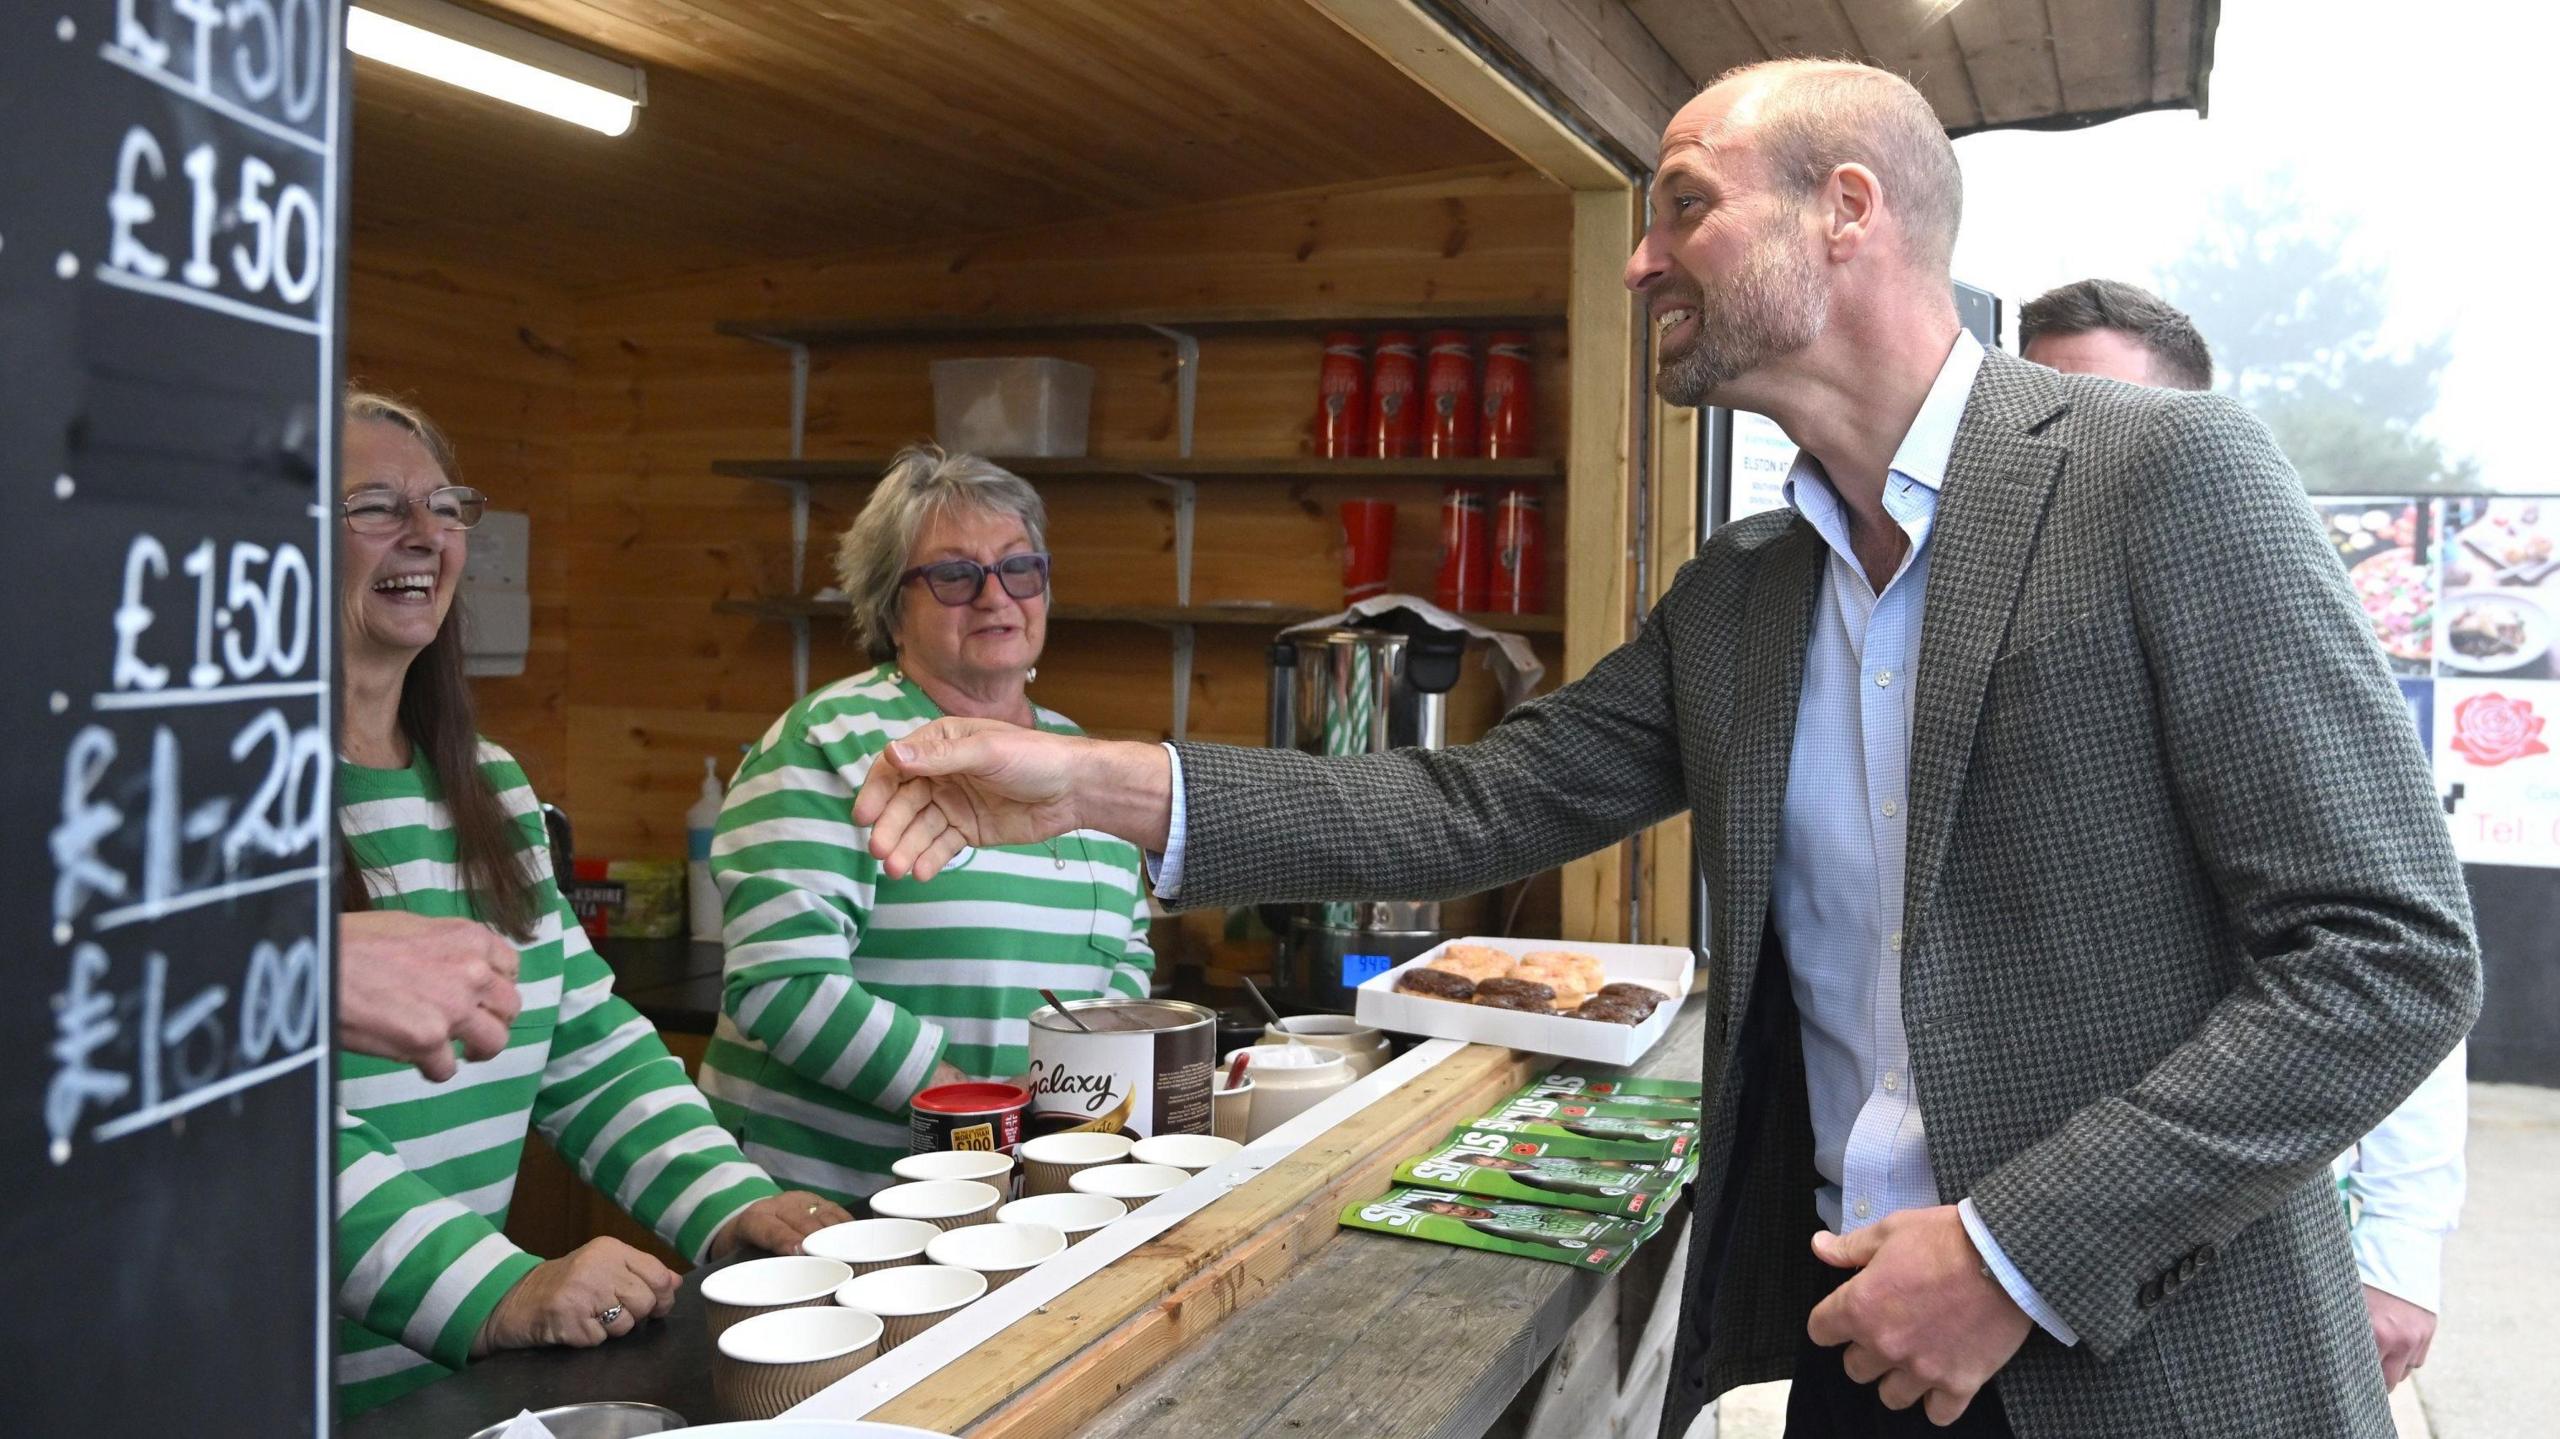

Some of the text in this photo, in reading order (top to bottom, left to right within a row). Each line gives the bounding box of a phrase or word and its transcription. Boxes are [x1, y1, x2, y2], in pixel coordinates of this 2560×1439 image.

[112, 533, 313, 689] £1.50
[570, 887, 623, 904] KSHIRE
[1028, 1059, 1119, 1112] Galaxy
